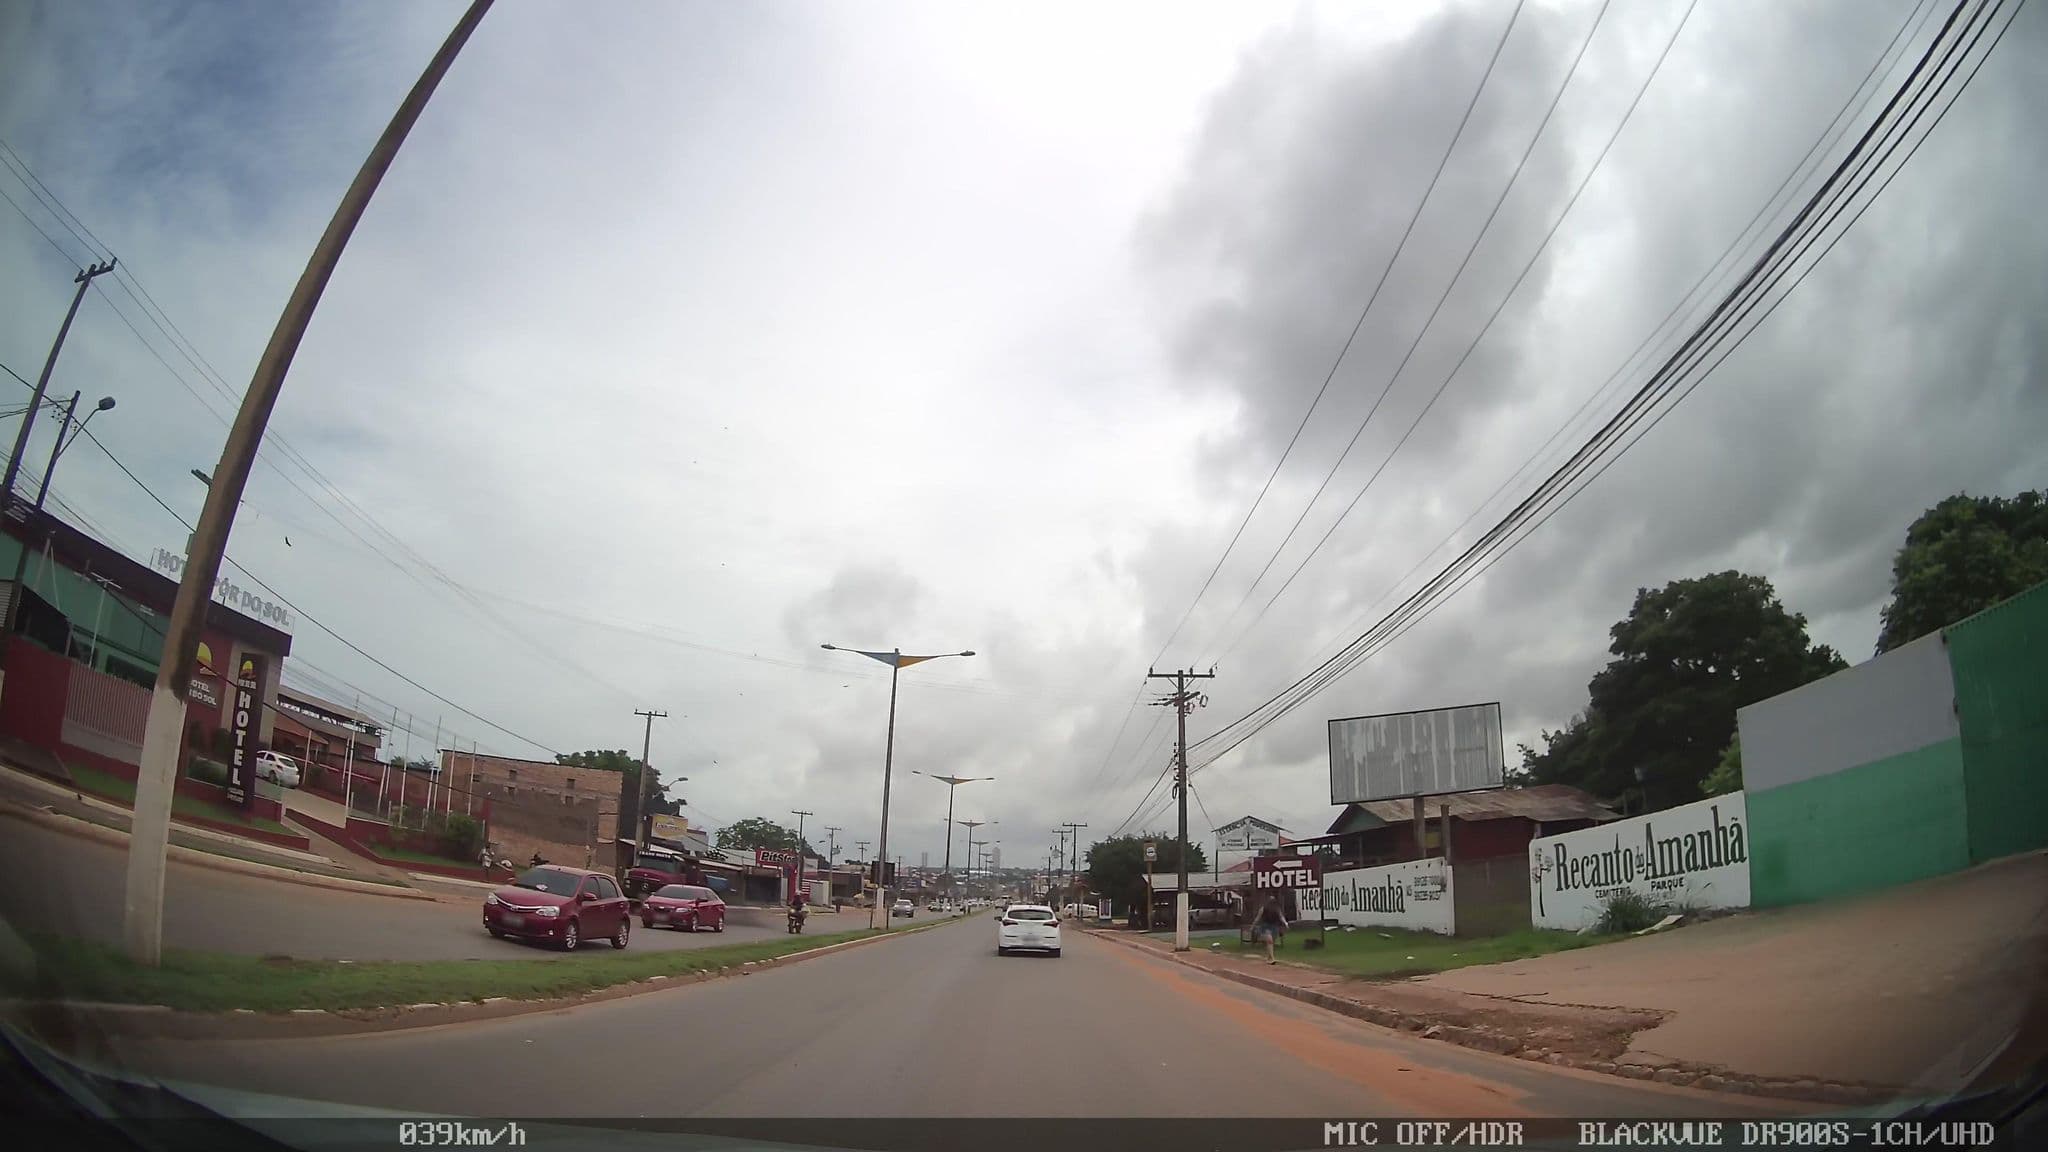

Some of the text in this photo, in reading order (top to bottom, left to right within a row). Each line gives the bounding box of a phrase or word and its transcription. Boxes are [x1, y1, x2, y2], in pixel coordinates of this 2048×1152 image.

[262, 600, 290, 627] SOL
[232, 691, 251, 785] HOTEL
[1554, 832, 1634, 892] Recanto
[1644, 805, 1748, 881] Amanhã
[1257, 869, 1318, 889] HOTEL
[1350, 874, 1406, 914] Amanhã
[1651, 877, 1684, 893] PARQUE
